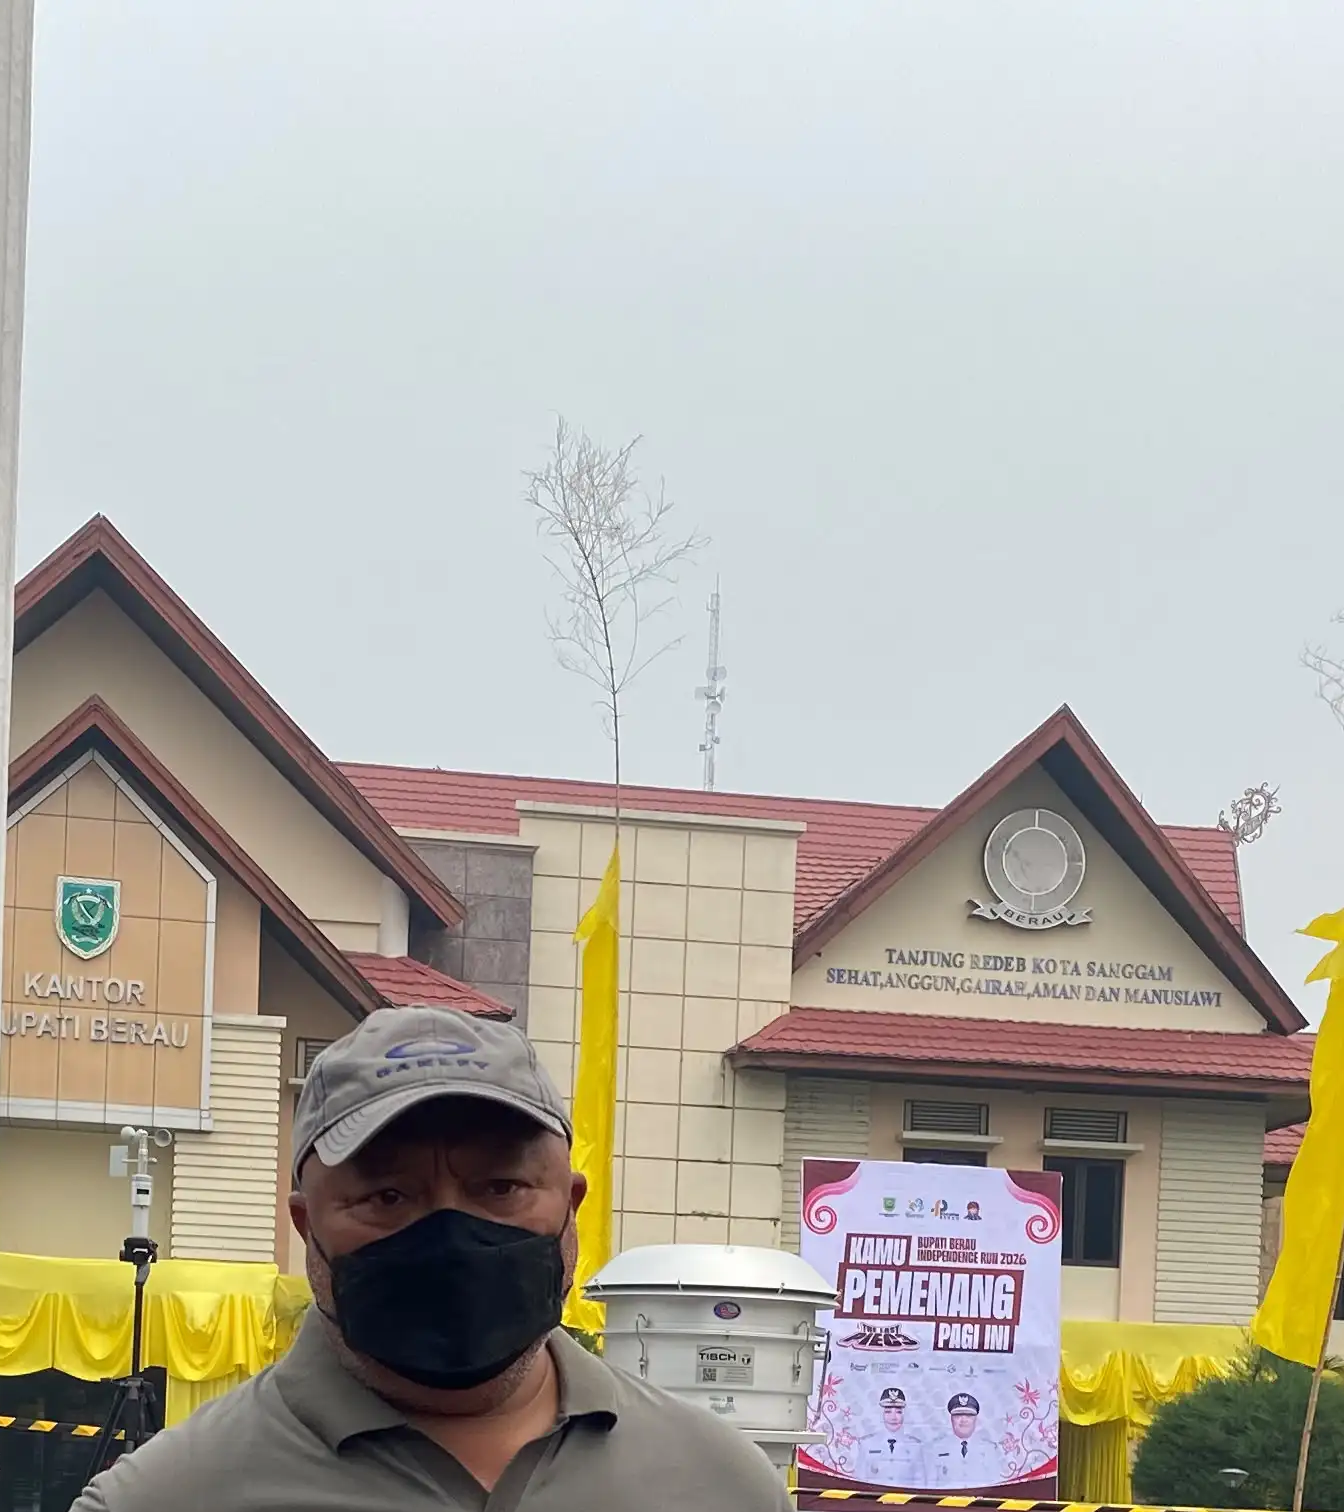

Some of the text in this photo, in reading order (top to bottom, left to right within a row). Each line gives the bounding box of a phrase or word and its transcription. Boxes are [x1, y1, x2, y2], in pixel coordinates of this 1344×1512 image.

[1003, 908, 1064, 926] BERAU
[885, 948, 1174, 982] TANJUNG REDEB KOTA SANGGAM
[22, 972, 146, 1006] KANTOR
[1085, 985, 1121, 1002] DAN
[1124, 988, 1223, 1008] MANUSIAWI
[0, 1011, 189, 1049] UPATI BERAU
[849, 1237, 907, 1266] KAMU
[917, 1236, 977, 1250] BUPATI BERAU
[917, 1249, 979, 1264] INDEPENDENCE
[842, 1269, 1015, 1320] PEMENANG
[938, 1323, 1011, 1351] PAGI INI
[698, 1352, 737, 1362] TISCH
